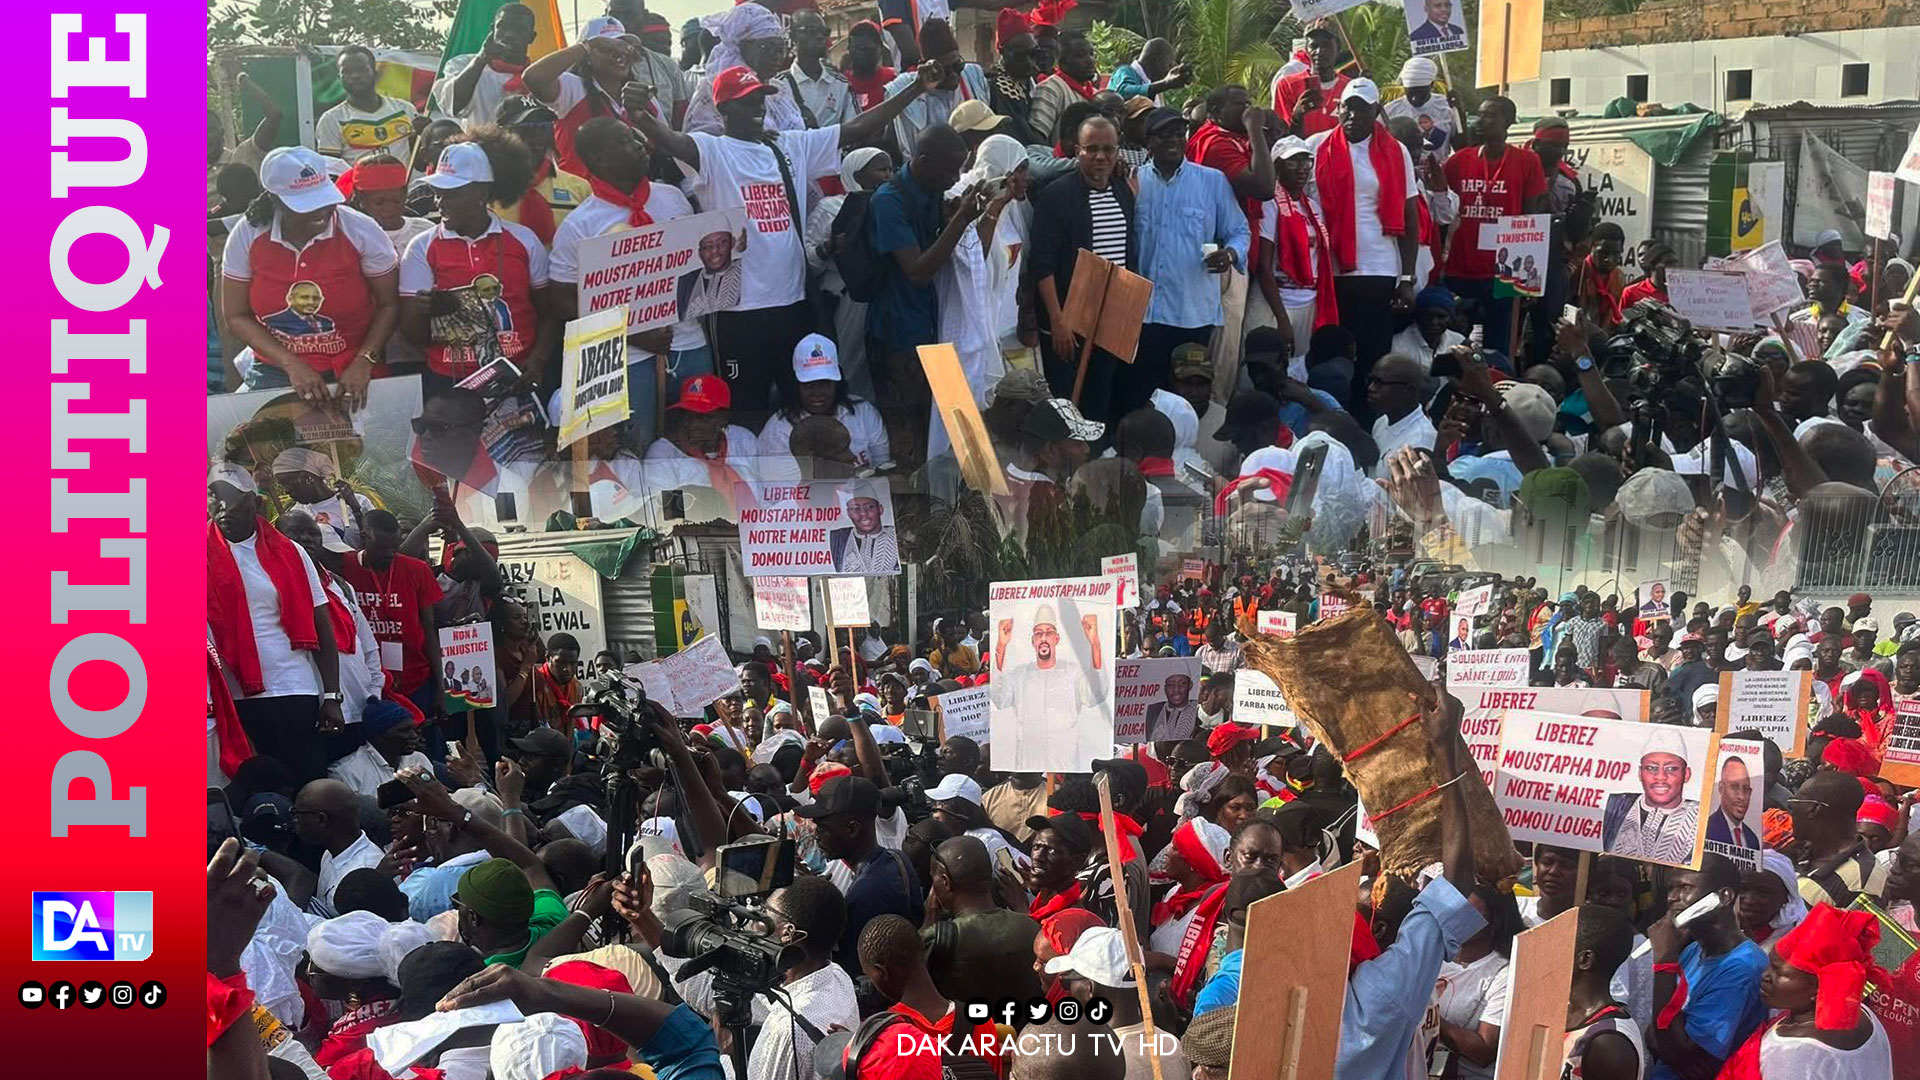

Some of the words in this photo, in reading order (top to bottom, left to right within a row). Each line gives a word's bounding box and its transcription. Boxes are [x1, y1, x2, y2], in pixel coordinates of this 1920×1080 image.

[1587, 173, 1614, 192] LA
[741, 183, 786, 201] LIBERE
[1597, 196, 1637, 216] WAL
[757, 220, 790, 232] DIOP
[1510, 219, 1528, 229] NON
[611, 231, 664, 257] LIBEREZ
[1496, 232, 1545, 243] L'INJUSTICE
[583, 255, 663, 290] MOUSTAPHA
[665, 249, 693, 269] DIOP
[590, 286, 633, 312] NOTRE
[635, 276, 675, 301] MAIRE
[638, 300, 676, 324] LOUGA
[764, 486, 811, 500] LIBEREZ
[741, 508, 813, 523] MOUSTAPHA
[815, 507, 841, 522] DIOP
[749, 530, 787, 544] NOTRE
[790, 529, 826, 543] MAIRE
[752, 552, 792, 567] DOMOU
[795, 551, 831, 565] LOUGA
[538, 587, 565, 607] LA
[990, 587, 1027, 600] LIBEREZ
[1029, 584, 1086, 599] MOUSTAPHA
[1088, 583, 1111, 596] DIOP
[356, 592, 402, 608] APEL
[369, 621, 403, 635] RDRE
[453, 630, 471, 641] NON
[1115, 665, 1140, 679] EREZ
[1454, 668, 1517, 682] SAINT-LOUIS
[1140, 684, 1160, 696] DIOP
[1248, 688, 1281, 698] LIBEREZ
[948, 692, 985, 705] LIBEREZ
[1239, 700, 1265, 710] FARBA
[1479, 692, 1537, 710] LIBEREZ
[961, 713, 981, 722] DIOP
[1116, 703, 1145, 717] MAIRE
[1117, 723, 1145, 736] LOUGA
[1535, 722, 1598, 746] LIBEREZ
[1502, 750, 1595, 778] MOUSTAPHA
[1595, 759, 1631, 782] DIOP
[1505, 779, 1551, 802] NOTRE
[1554, 782, 1605, 808] MAIRE
[1503, 808, 1551, 831] DOMOU
[1554, 815, 1601, 839] LOUGA
[1704, 840, 1729, 855] NOTRE
[1729, 845, 1755, 860] MAIRE
[1733, 859, 1757, 872] OUGA
[1174, 914, 1206, 977] LIBEREZ
